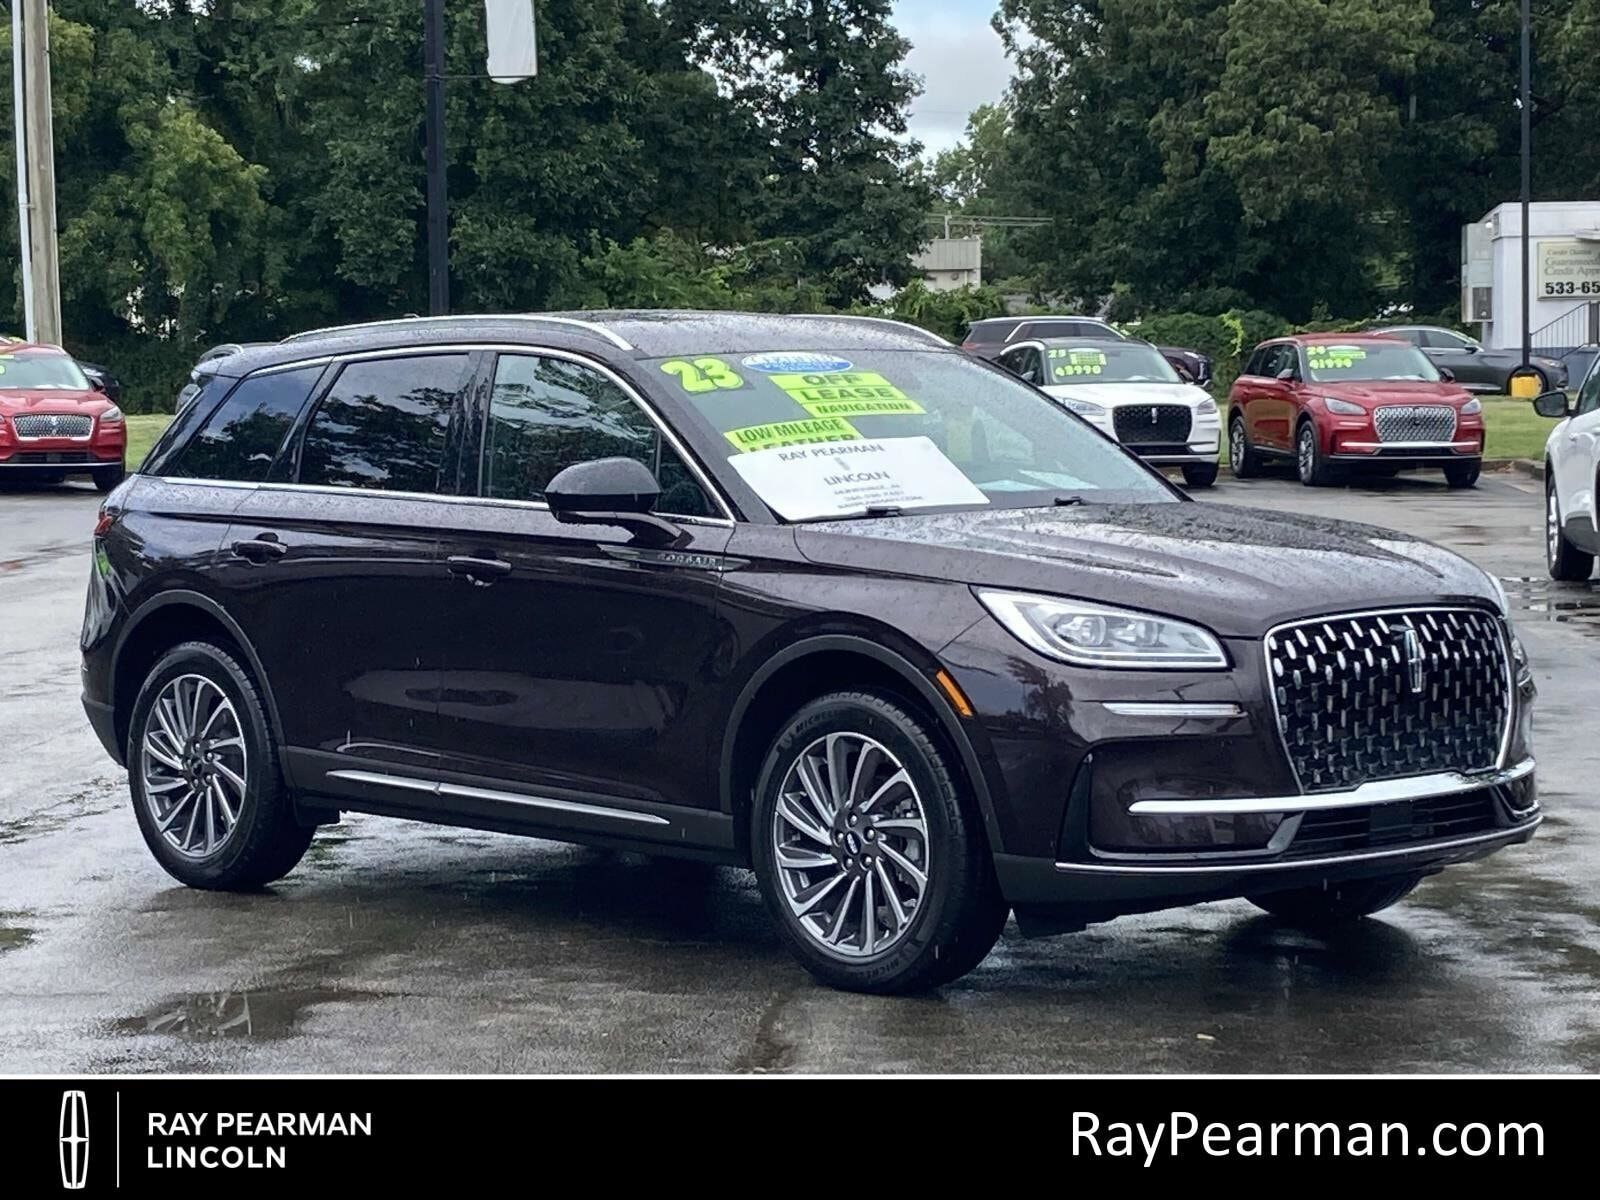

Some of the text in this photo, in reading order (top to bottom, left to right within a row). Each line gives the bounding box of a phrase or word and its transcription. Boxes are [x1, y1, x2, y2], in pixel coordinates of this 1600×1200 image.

[660, 357, 744, 393] 23
[802, 374, 864, 386] OFF
[800, 388, 896, 401] LEASE
[816, 402, 912, 414] NAVIGATION
[735, 419, 846, 443] LOW MILEAGE
[779, 443, 885, 462] RAY PEARMAN
[823, 470, 891, 486] LINCOLN
